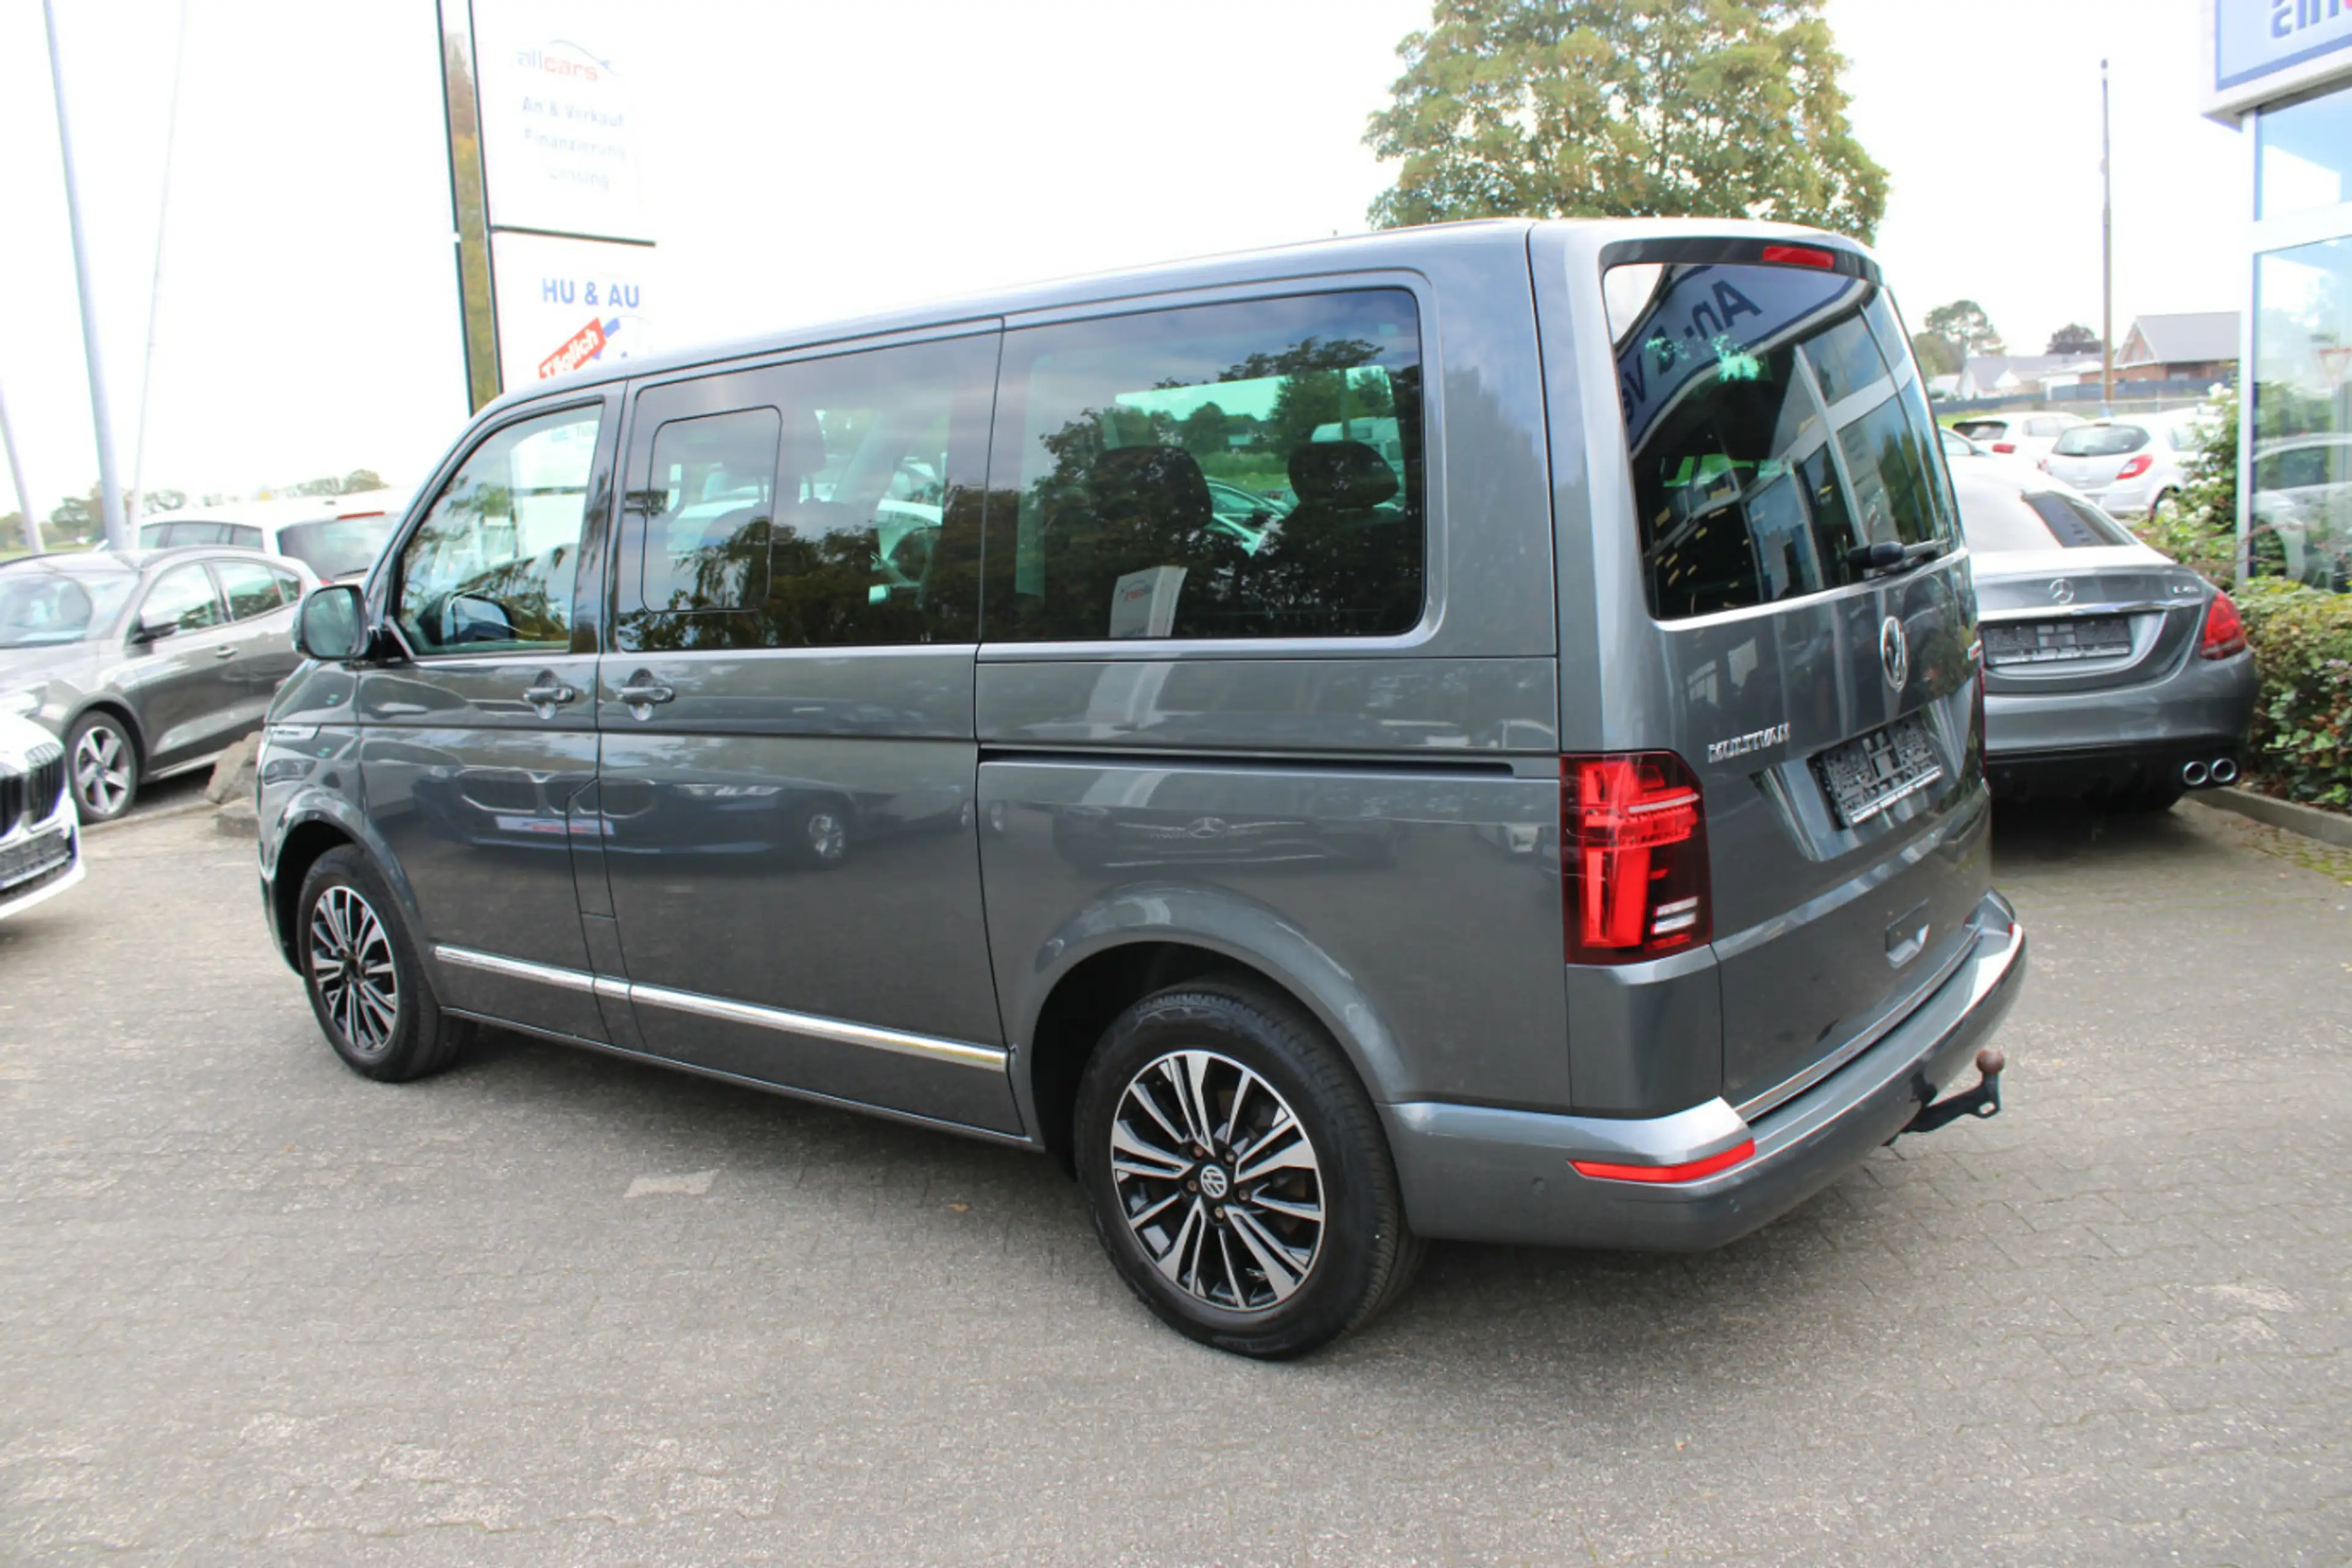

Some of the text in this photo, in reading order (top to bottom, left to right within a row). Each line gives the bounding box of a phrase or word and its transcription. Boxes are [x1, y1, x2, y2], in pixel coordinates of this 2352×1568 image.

[518, 50, 598, 86] allcars
[564, 103, 624, 127] Verkauf
[541, 278, 639, 309] HU & AU
